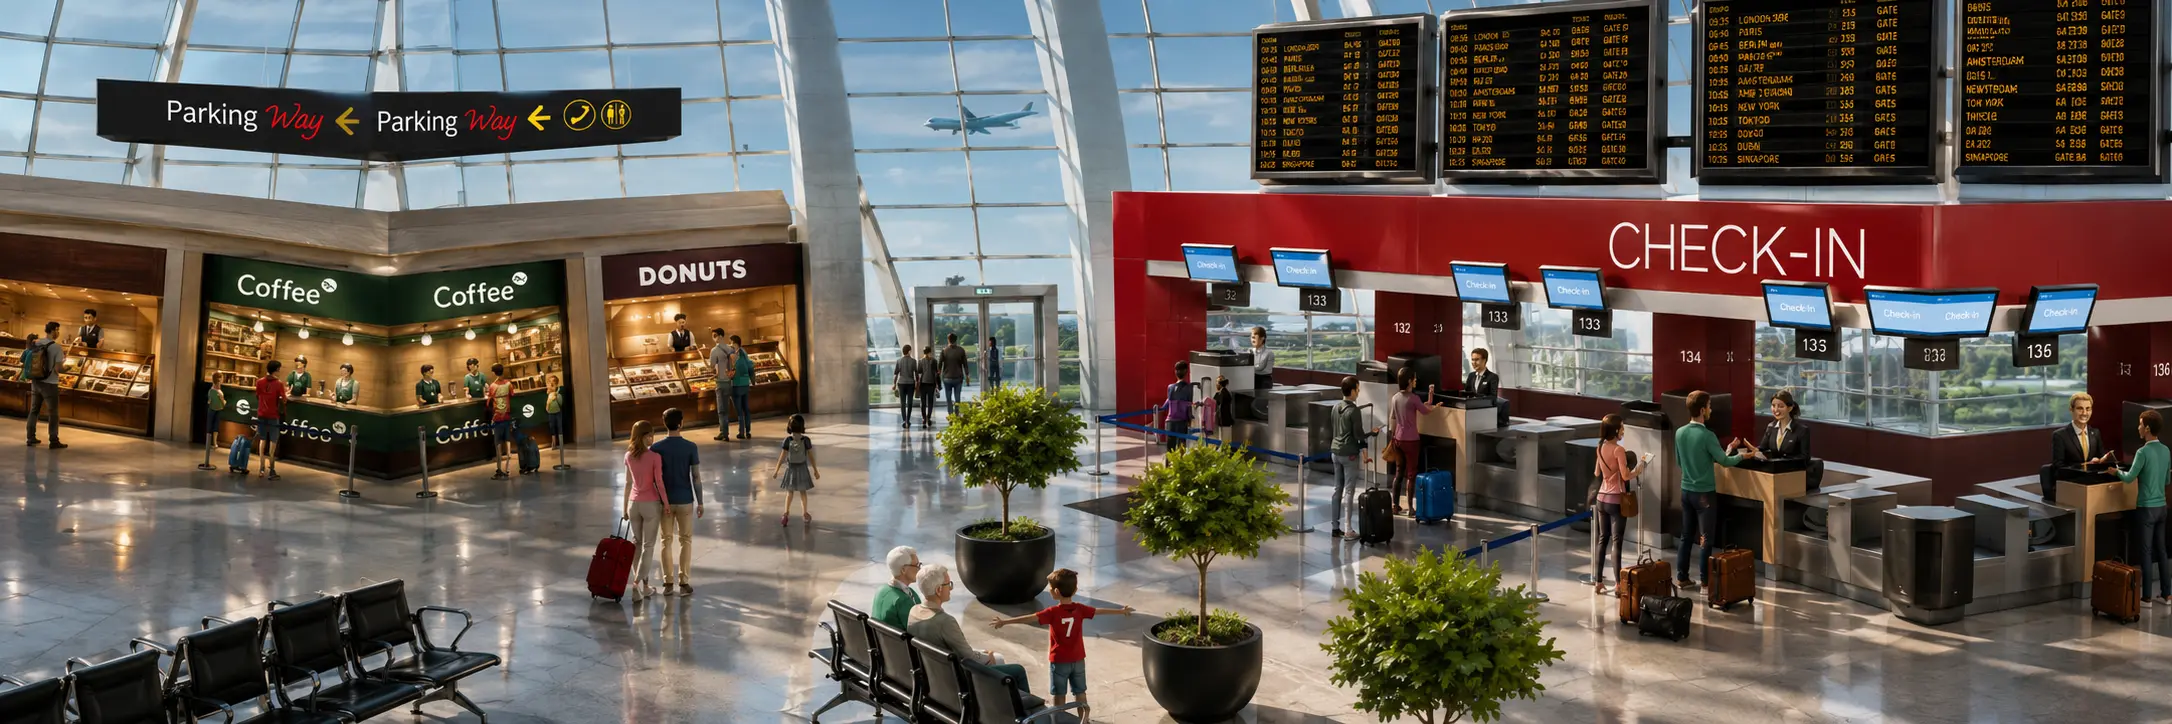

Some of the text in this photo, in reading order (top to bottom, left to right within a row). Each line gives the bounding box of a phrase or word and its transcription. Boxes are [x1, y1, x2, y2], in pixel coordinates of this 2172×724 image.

[1877, 5, 1898, 15] GATE
[1877, 18, 1898, 28] GATE
[167, 99, 324, 140] Parking Way
[377, 105, 518, 141] Parking Way
[1608, 221, 1865, 280] CHECK-IN
[638, 259, 747, 287] DONUTS
[237, 274, 320, 305] Coffee
[433, 282, 515, 309] Coffee
[1307, 294, 1328, 307] 133
[1488, 310, 1509, 323] 133
[1883, 308, 1921, 319] Check-in
[1393, 322, 1411, 334] 132
[1578, 317, 1601, 331] 133
[1680, 350, 1702, 364] 134
[2027, 343, 2052, 359] 136
[2152, 362, 2171, 377] 136
[1061, 617, 1075, 638] 7
